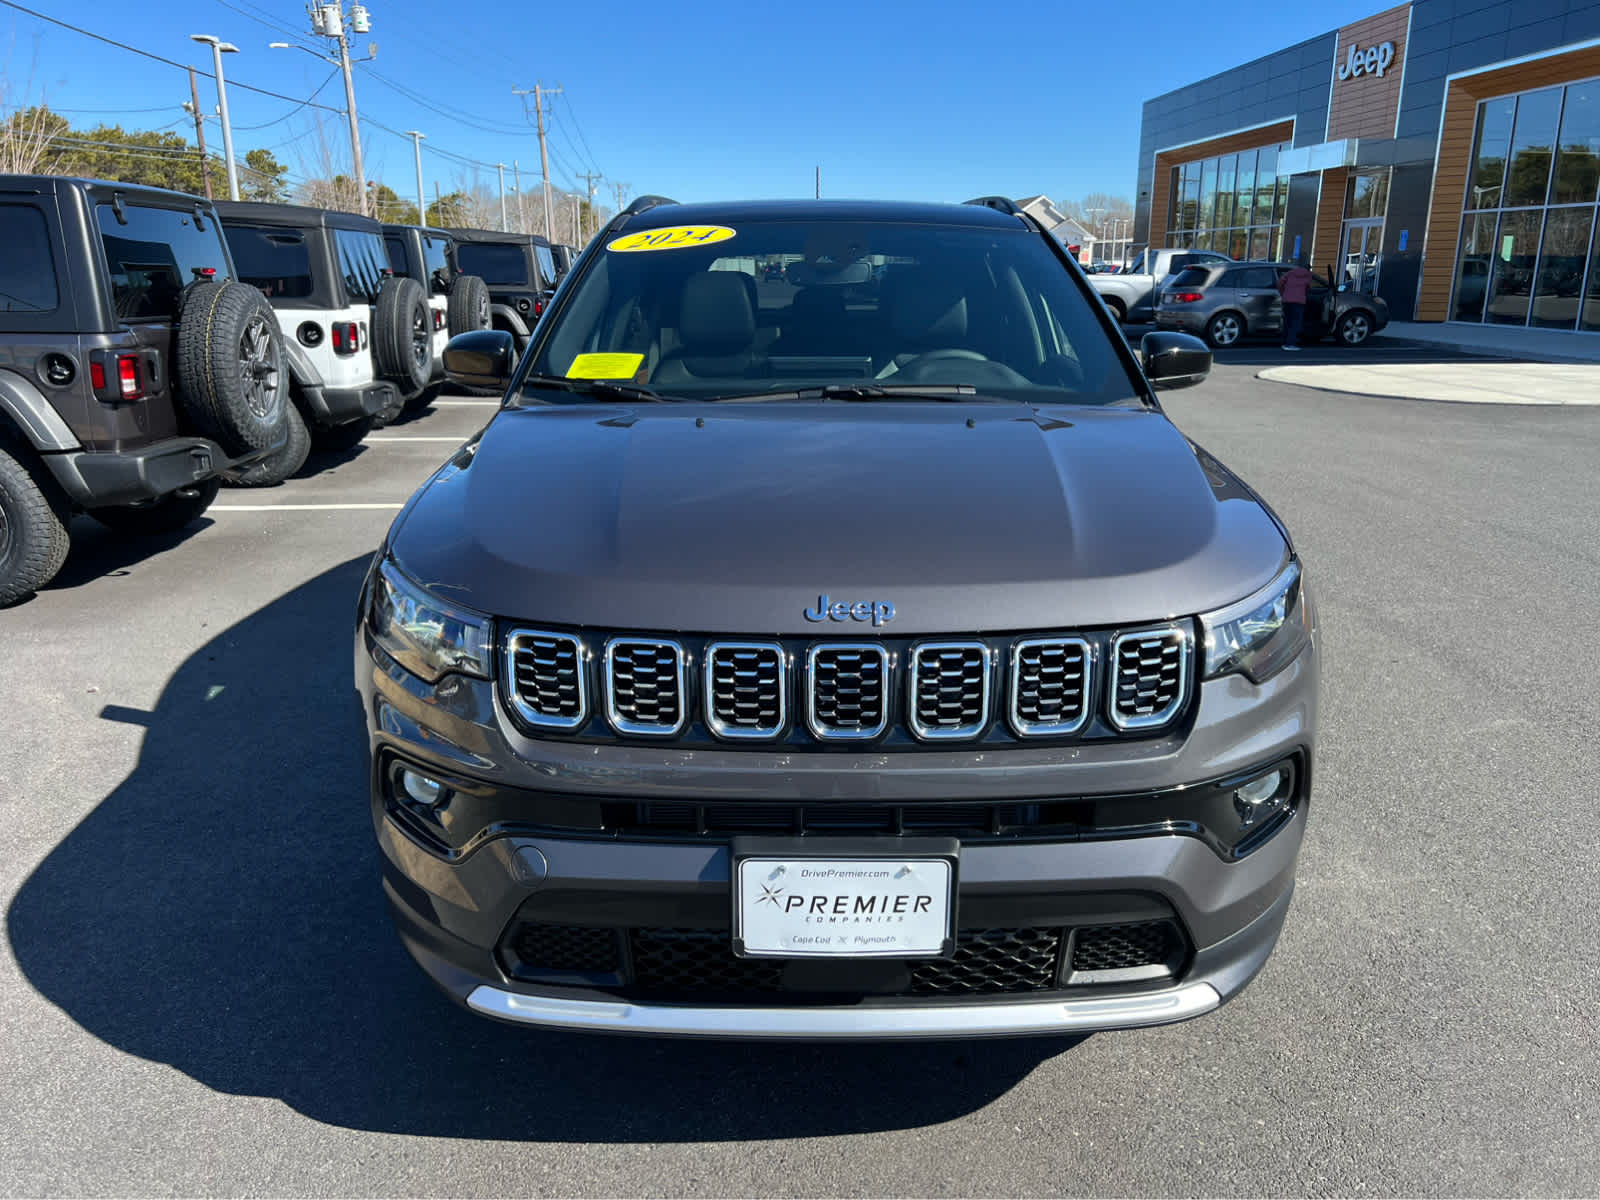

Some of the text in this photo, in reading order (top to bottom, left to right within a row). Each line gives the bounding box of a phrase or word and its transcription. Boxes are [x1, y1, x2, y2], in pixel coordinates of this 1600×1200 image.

[1338, 41, 1395, 80] Jeep
[625, 229, 719, 249] 2024
[803, 594, 896, 627] Jeep
[801, 869, 890, 879] DrivePremier.com
[784, 895, 932, 914] PREMIER
[805, 915, 904, 923] COMPANIES
[792, 934, 896, 946] Cape Cod Plymouth
